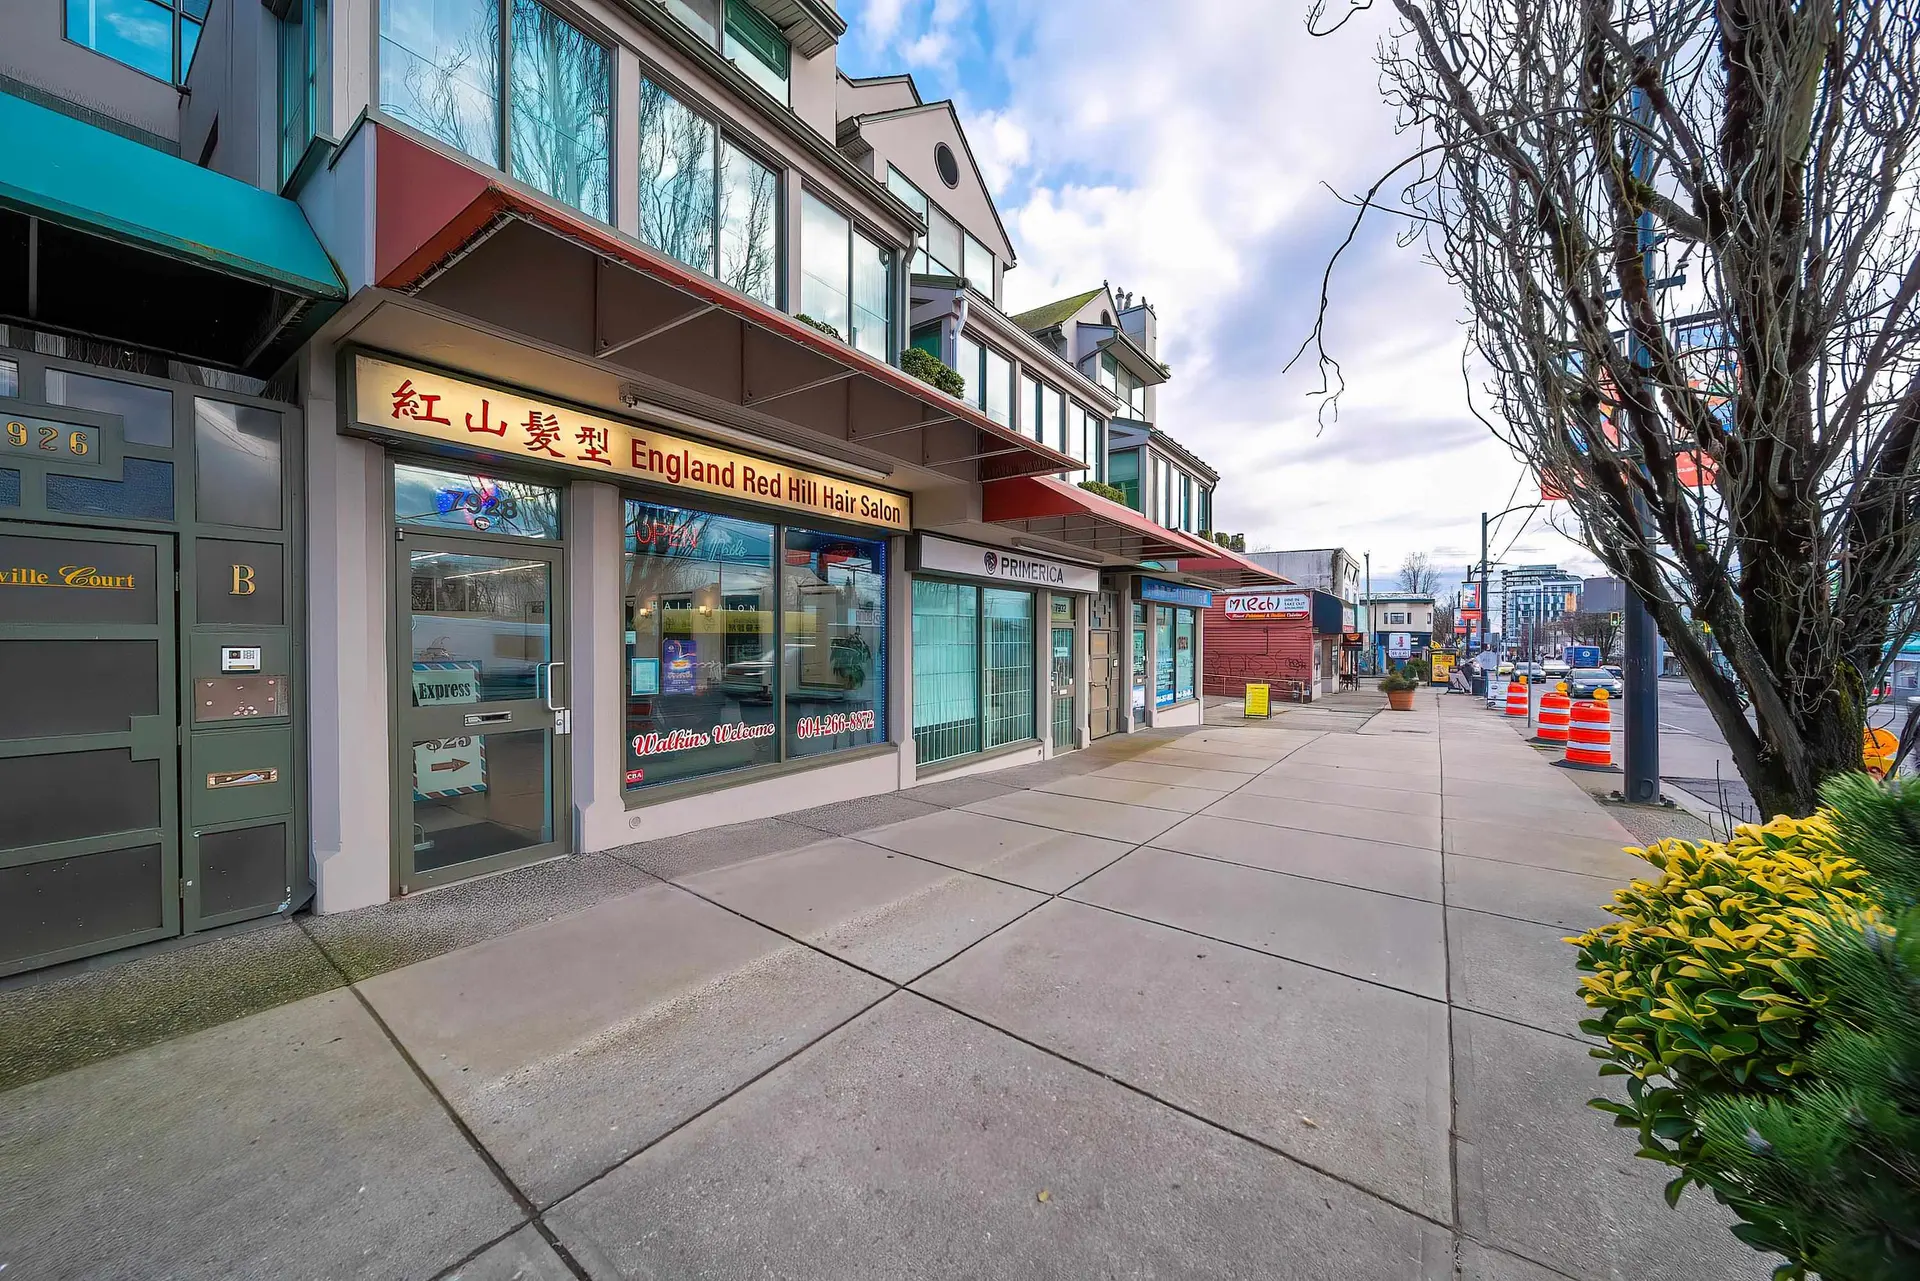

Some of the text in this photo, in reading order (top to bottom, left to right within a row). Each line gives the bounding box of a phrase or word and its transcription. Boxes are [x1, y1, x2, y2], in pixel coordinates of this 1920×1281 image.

[391, 379, 612, 466] 紅山髮型
[6, 421, 89, 456] 926
[631, 438, 900, 524] England Red Hill Hair Salon
[445, 489, 518, 519] 7928
[636, 520, 698, 548] OPEN
[58, 564, 136, 587] Court
[228, 564, 256, 595] B
[1001, 557, 1064, 584] PRIMERICA
[651, 601, 757, 612] HAIR ALON
[1055, 603, 1066, 612] 7932
[418, 682, 471, 700] Express
[632, 721, 775, 757] Walkins Welcome
[797, 709, 875, 739] 604-266-8872
